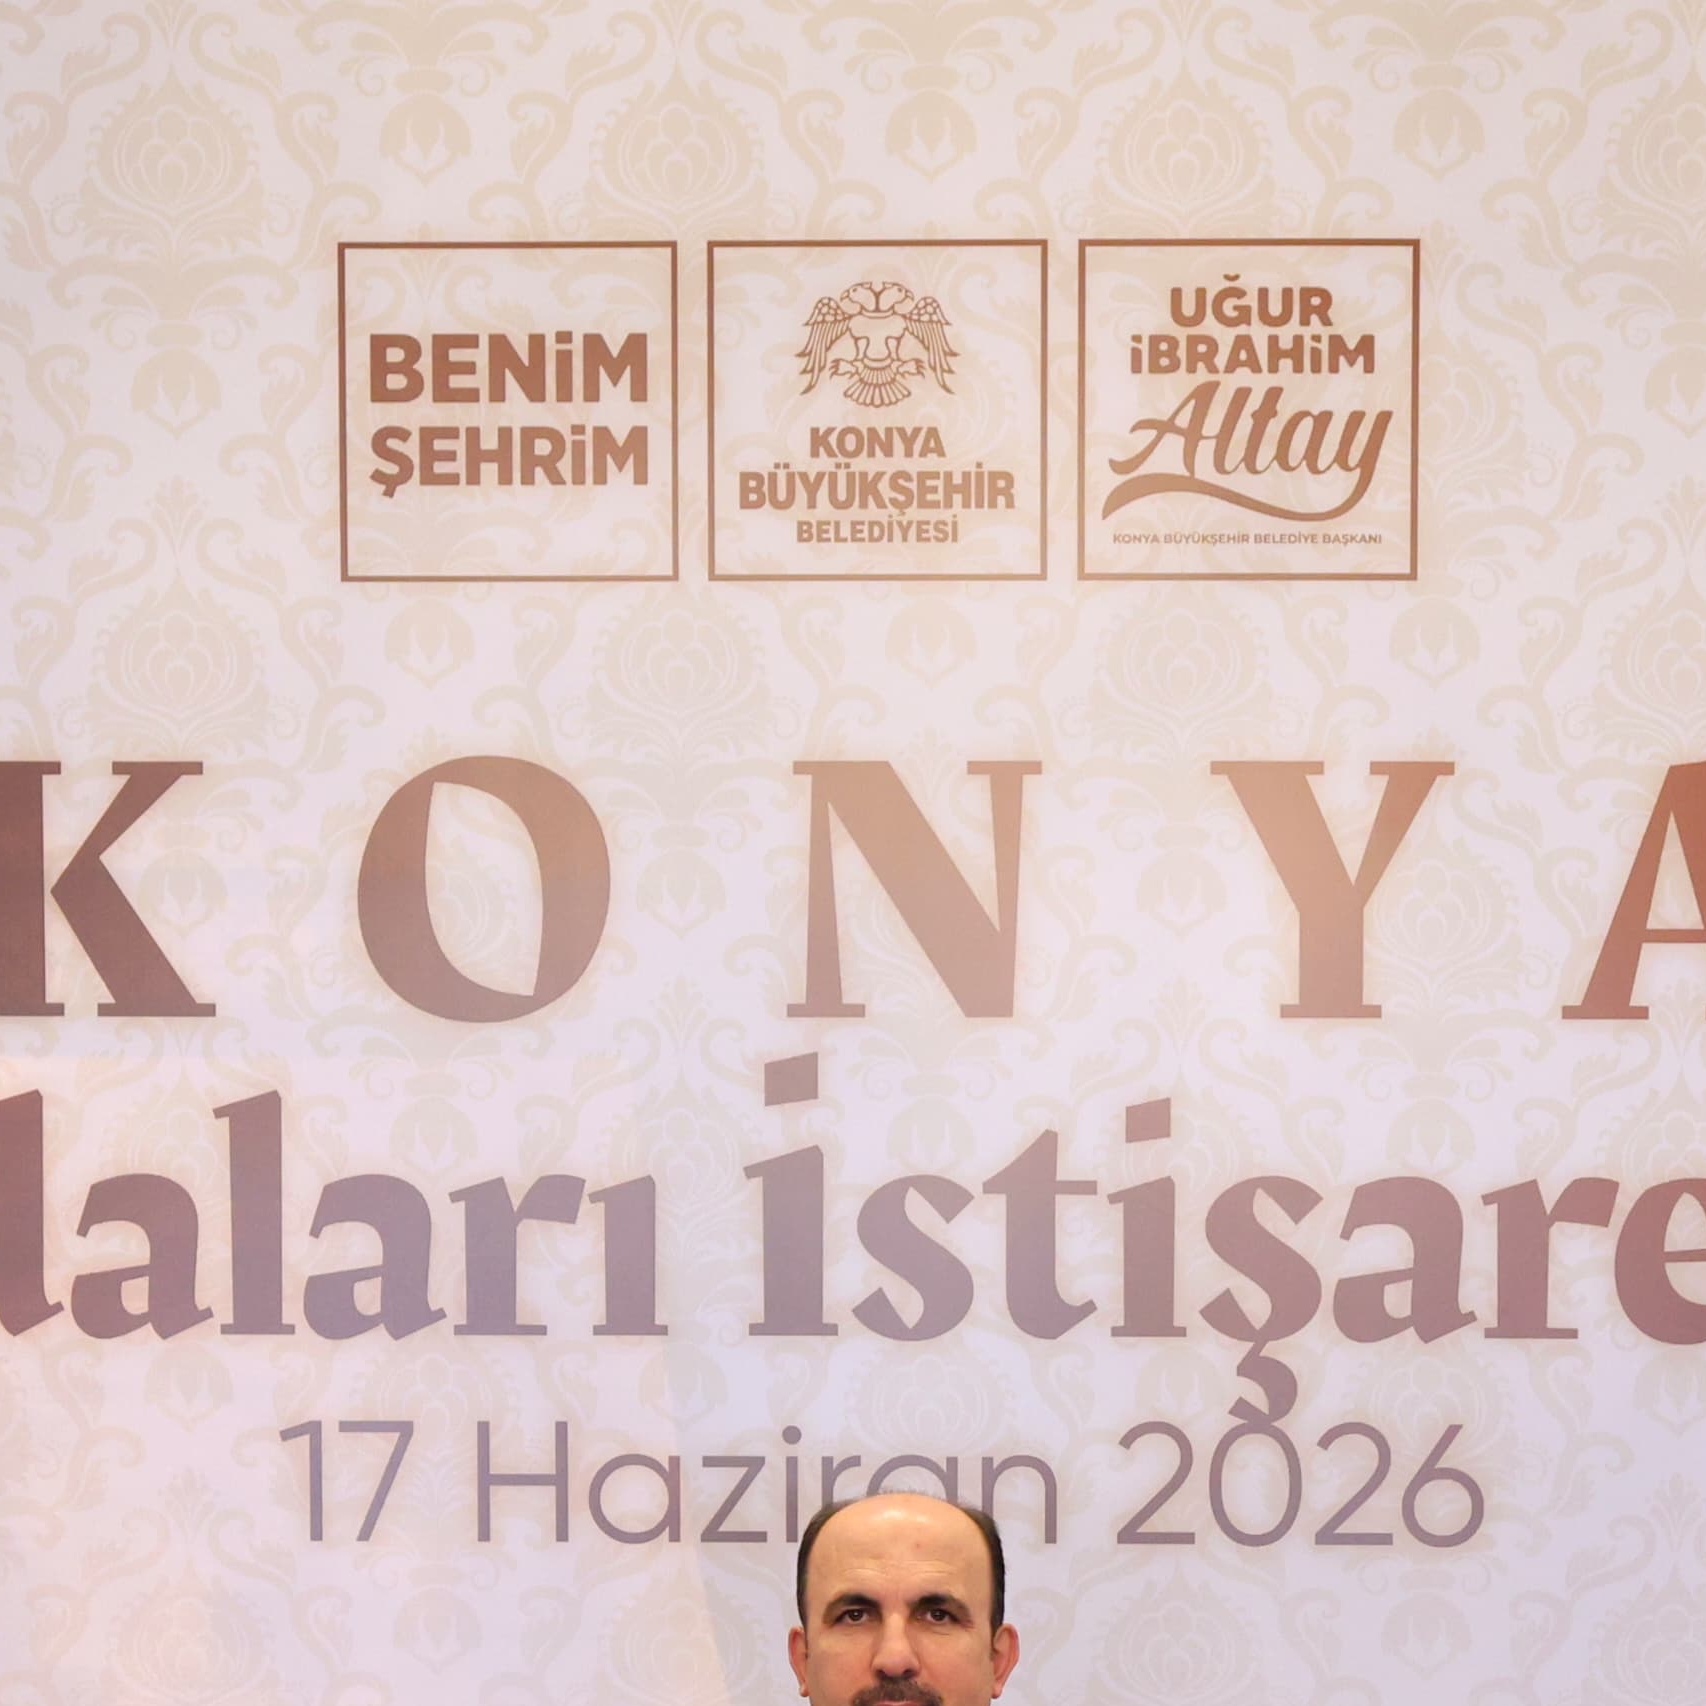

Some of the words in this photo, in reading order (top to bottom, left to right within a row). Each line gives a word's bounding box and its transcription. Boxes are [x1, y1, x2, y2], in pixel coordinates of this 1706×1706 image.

[1170, 274, 1333, 327] UĞUR
[809, 426, 946, 458] KONYA
[1102, 380, 1394, 522] Altay
[739, 462, 1015, 516] BÜYÜKŞEHİR
[796, 514, 958, 543] BELEDİYESİ
[1112, 532, 1160, 545] KONYA
[1164, 531, 1250, 547] BÜYÜKŞEHİR
[1253, 531, 1319, 545] BELEDİYE
[1322, 532, 1383, 547] BAŞKANI
[279, 1420, 417, 1544] 17
[1116, 1418, 1485, 1548] 2026
